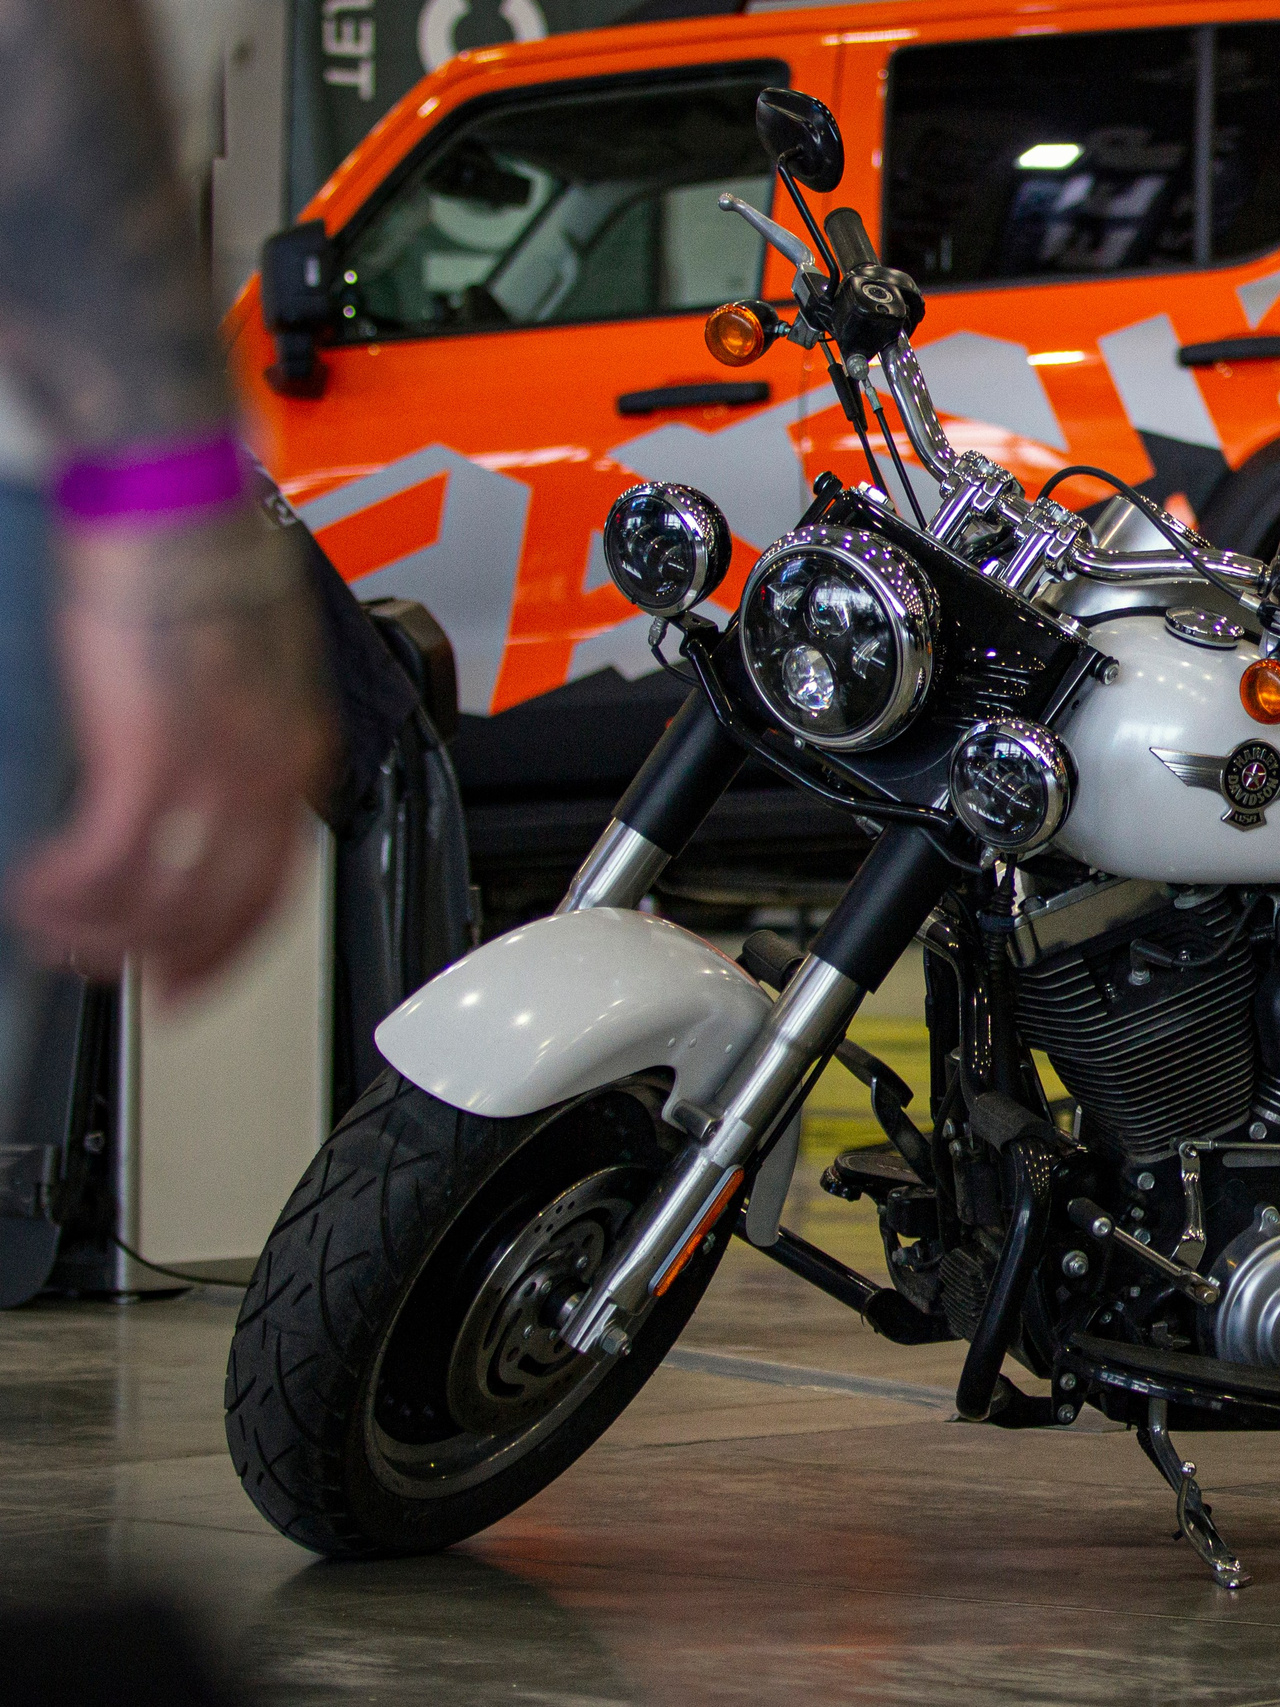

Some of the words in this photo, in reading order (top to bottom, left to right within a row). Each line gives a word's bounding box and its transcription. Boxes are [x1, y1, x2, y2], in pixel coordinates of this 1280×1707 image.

[1236, 748, 1278, 769] HARLEY
[1229, 775, 1279, 805] DAVIDSON
[1235, 814, 1258, 823] USA
